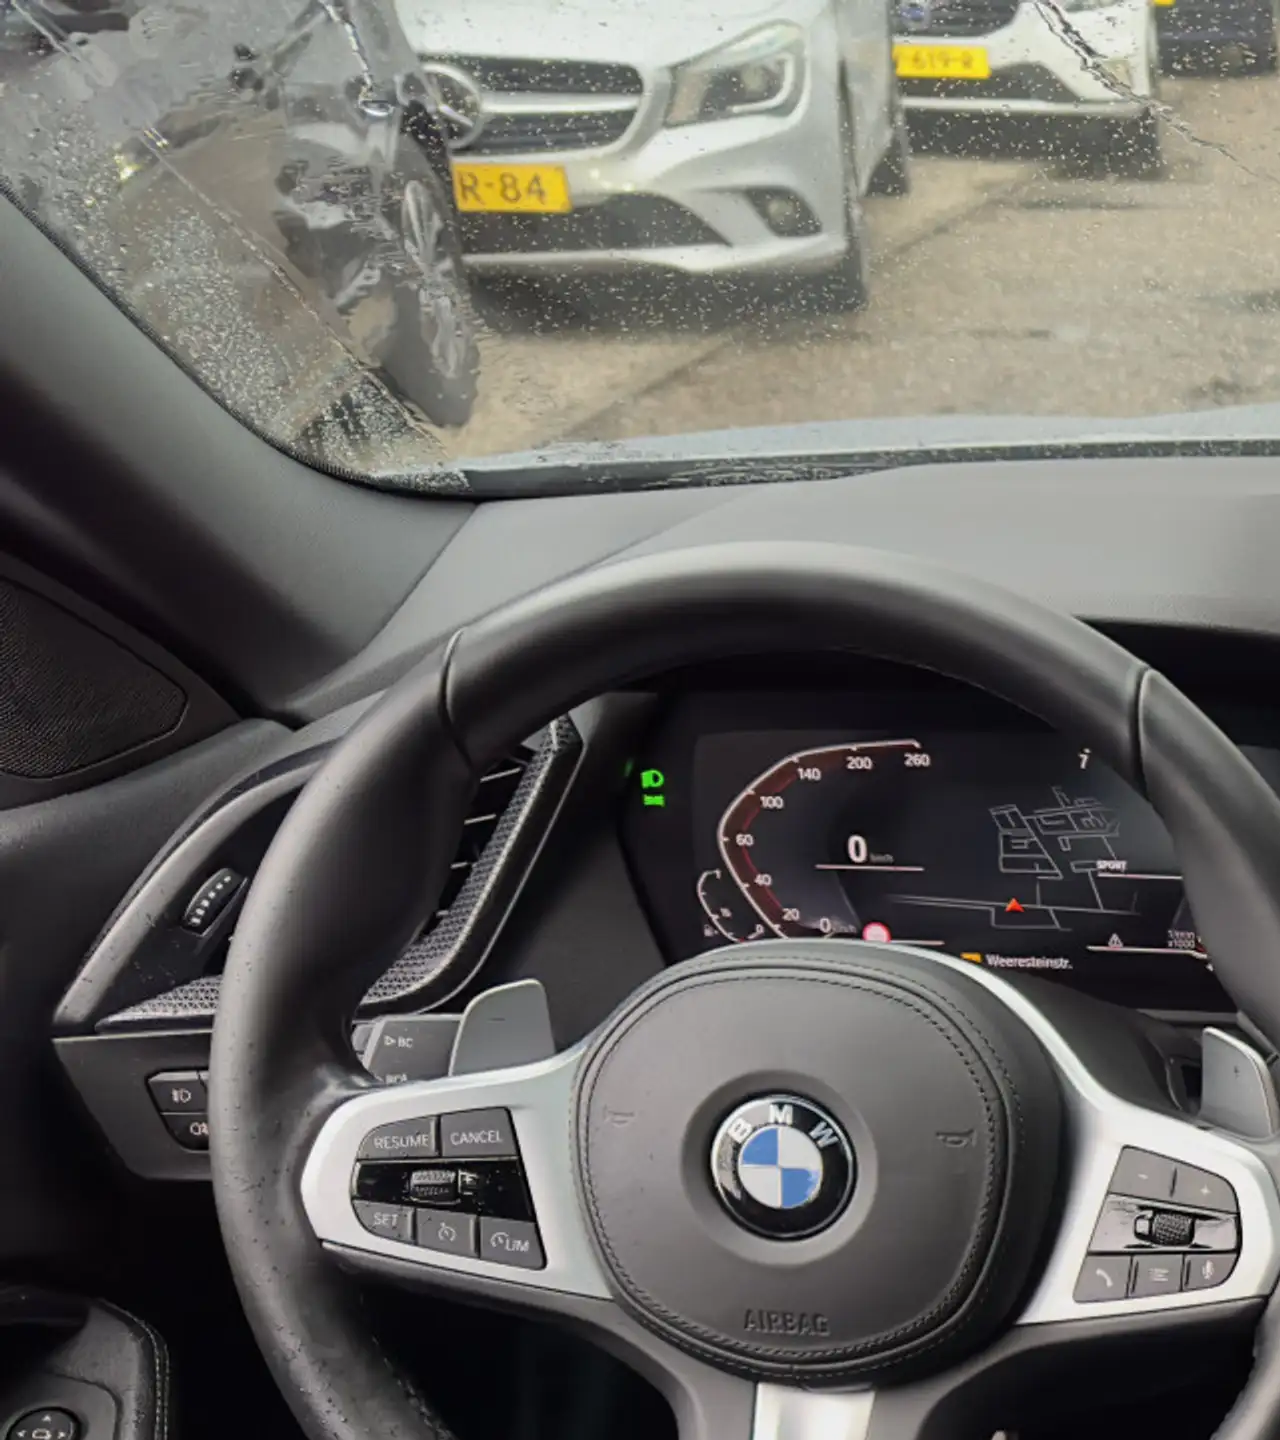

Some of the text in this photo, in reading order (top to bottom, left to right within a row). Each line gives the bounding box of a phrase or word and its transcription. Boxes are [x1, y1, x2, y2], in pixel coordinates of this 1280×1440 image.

[846, 756, 873, 770] 200
[904, 753, 931, 767] 260
[797, 767, 821, 781] 140
[760, 796, 784, 809] 100
[736, 834, 754, 846] 60
[847, 835, 867, 863] 0
[754, 874, 772, 886] 40
[782, 908, 800, 921] 20
[986, 954, 1073, 970] Weeresteinstr.
[727, 1104, 839, 1148] BMW
[373, 1133, 430, 1149] RESUME
[451, 1131, 503, 1145] CANCEL
[373, 1213, 398, 1226] SET
[505, 1238, 530, 1253] LIM
[743, 1308, 831, 1336] AIRBAG
